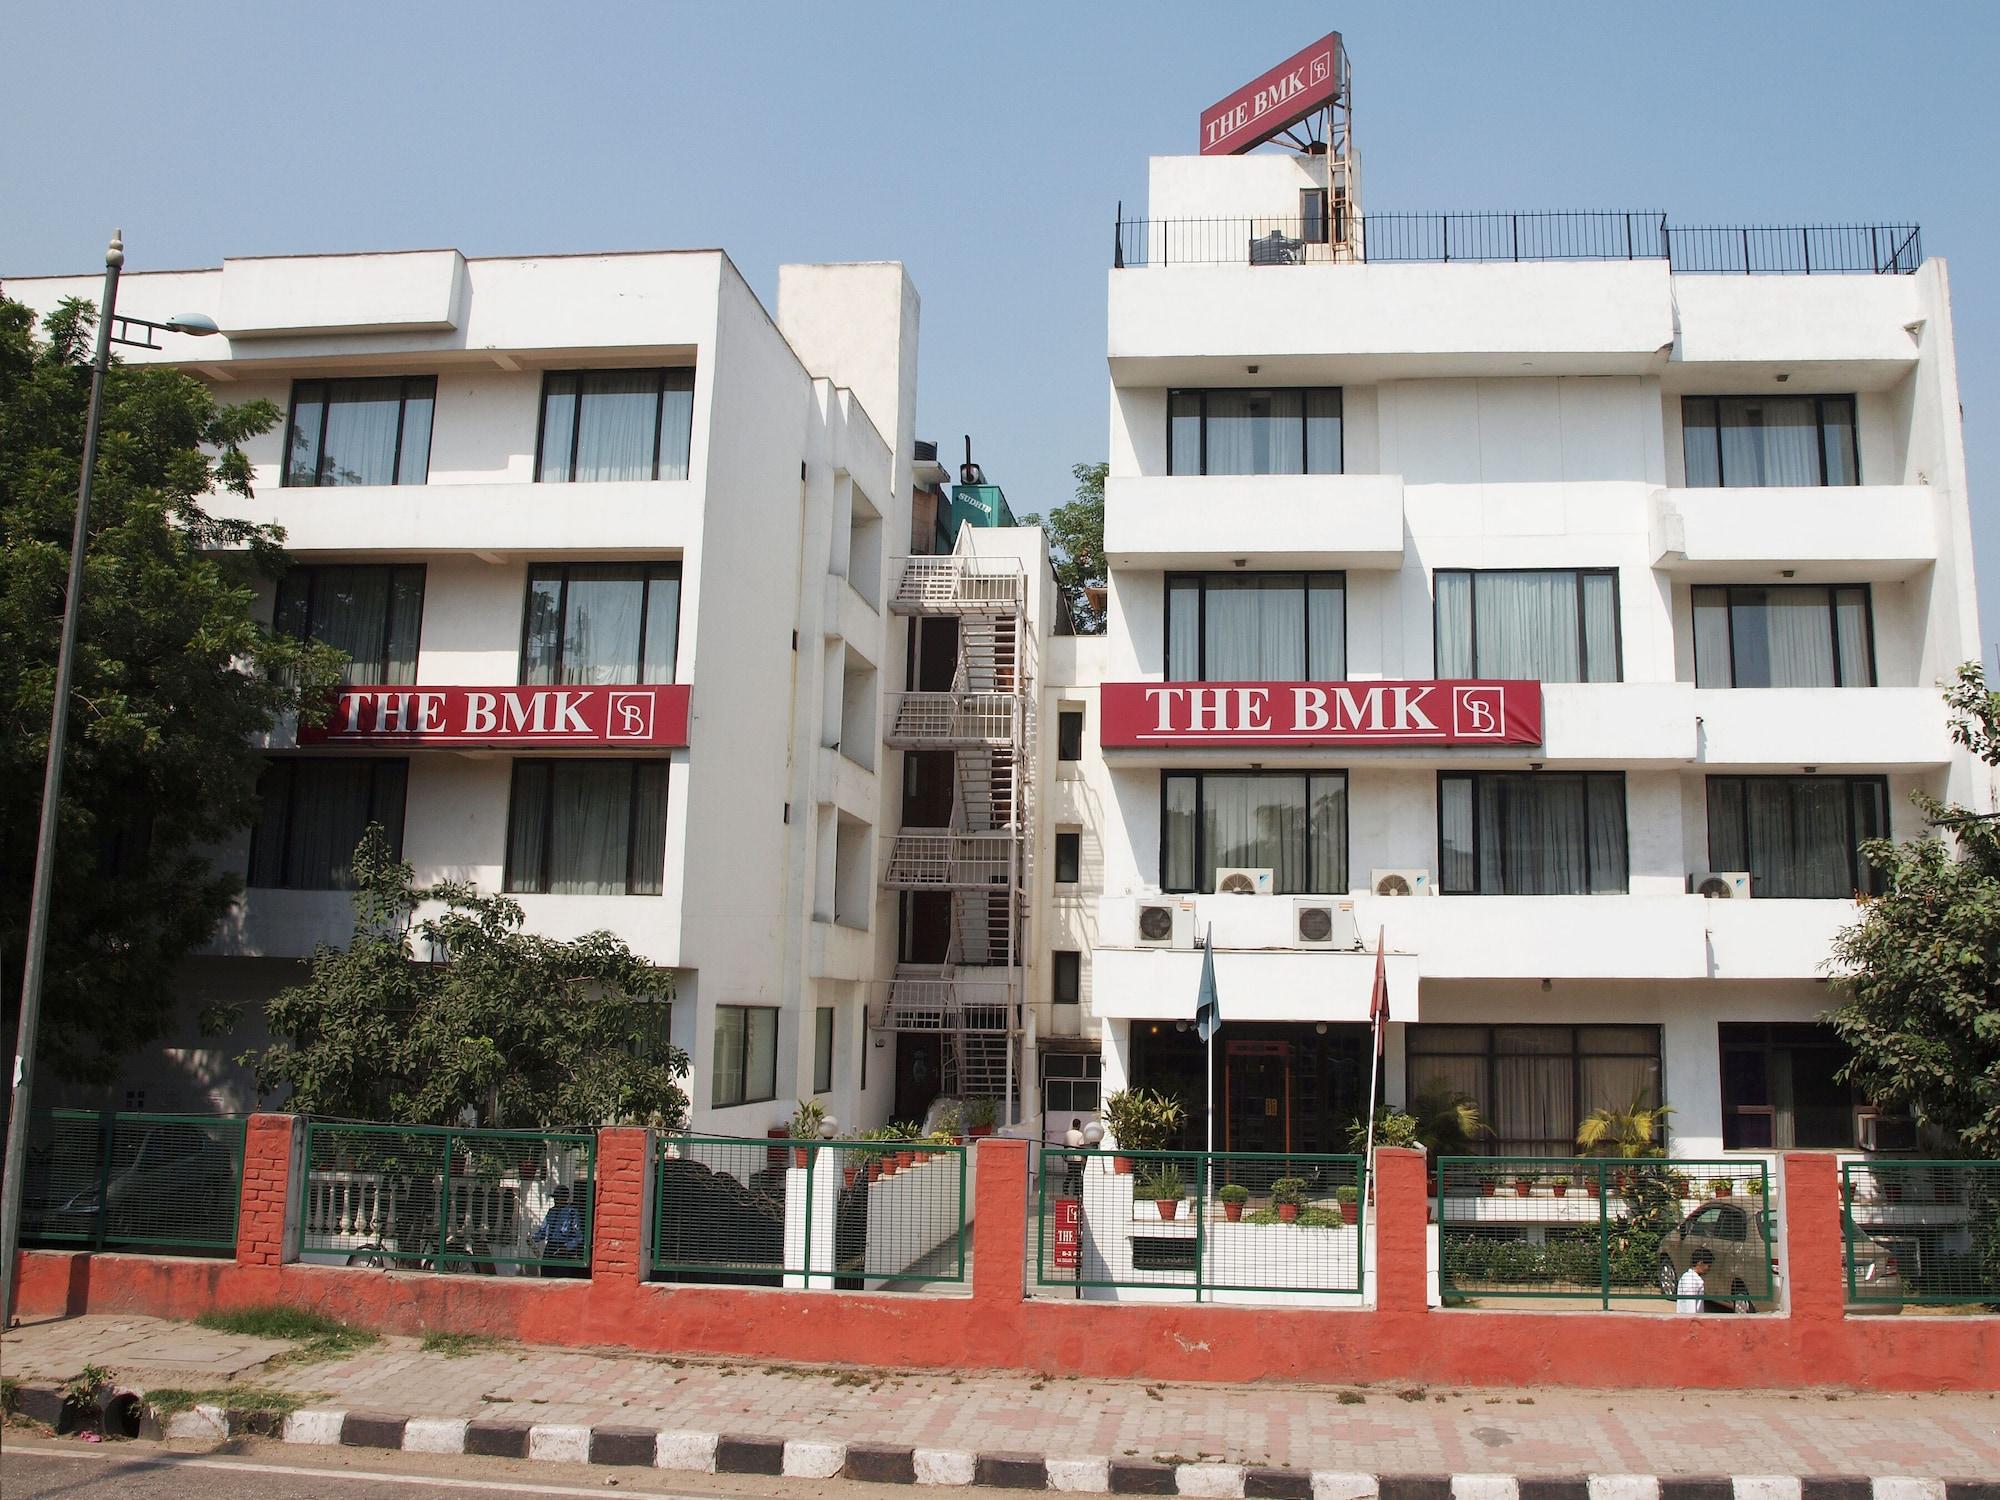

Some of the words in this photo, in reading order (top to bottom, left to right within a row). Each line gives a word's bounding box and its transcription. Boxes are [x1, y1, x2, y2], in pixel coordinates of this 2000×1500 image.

[1206, 102, 1248, 145] THE
[1253, 66, 1305, 117] BMK
[339, 692, 447, 733] THE
[461, 691, 594, 733] BMK
[1145, 687, 1272, 731] THE
[1289, 686, 1438, 731] BMK
